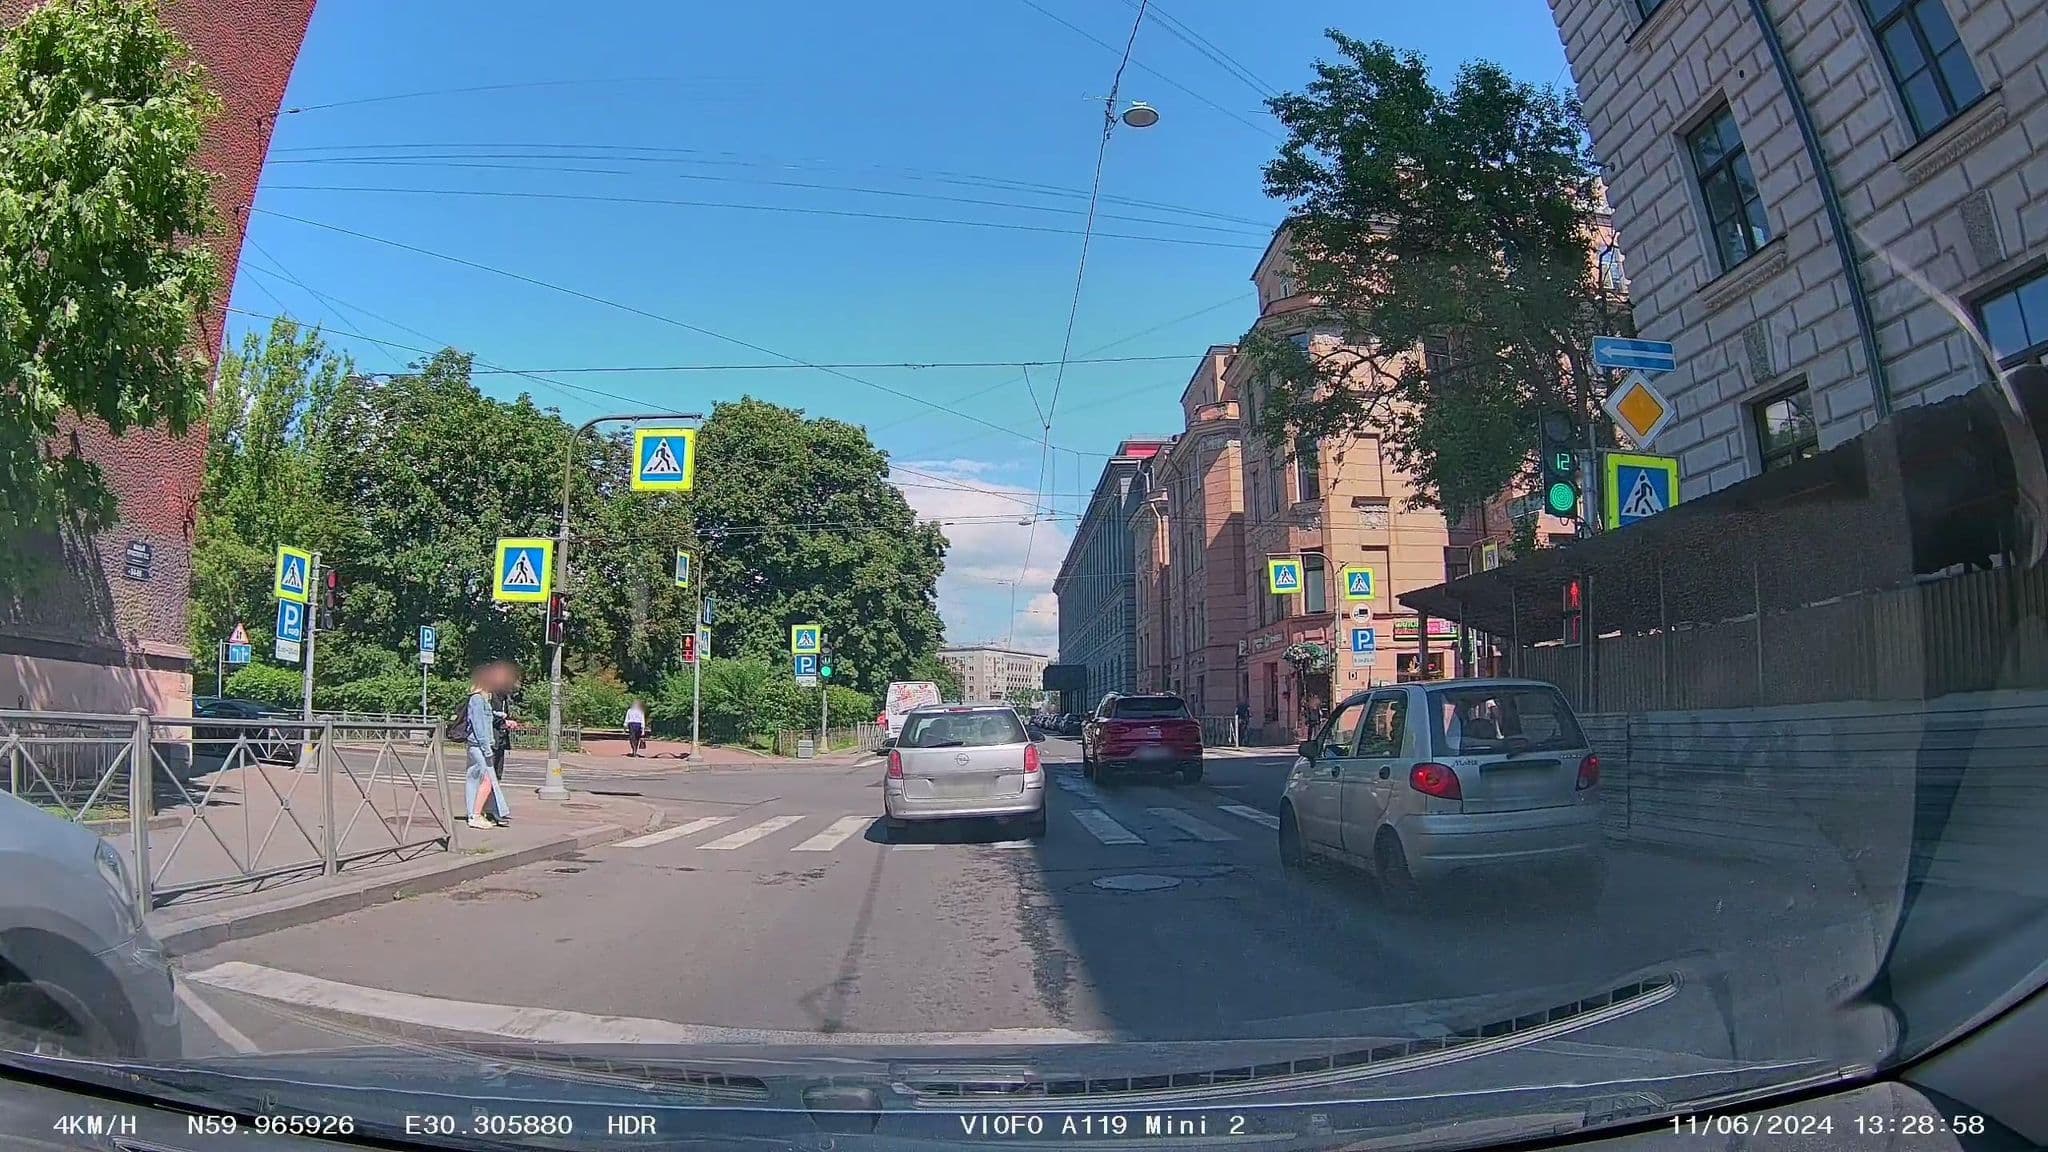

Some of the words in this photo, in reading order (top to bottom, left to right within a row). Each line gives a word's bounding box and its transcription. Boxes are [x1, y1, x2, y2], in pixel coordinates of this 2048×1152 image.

[1556, 453, 1570, 471] 12
[283, 604, 299, 635] P
[424, 628, 433, 648] P
[1357, 630, 1371, 650] P
[800, 656, 813, 674] P
